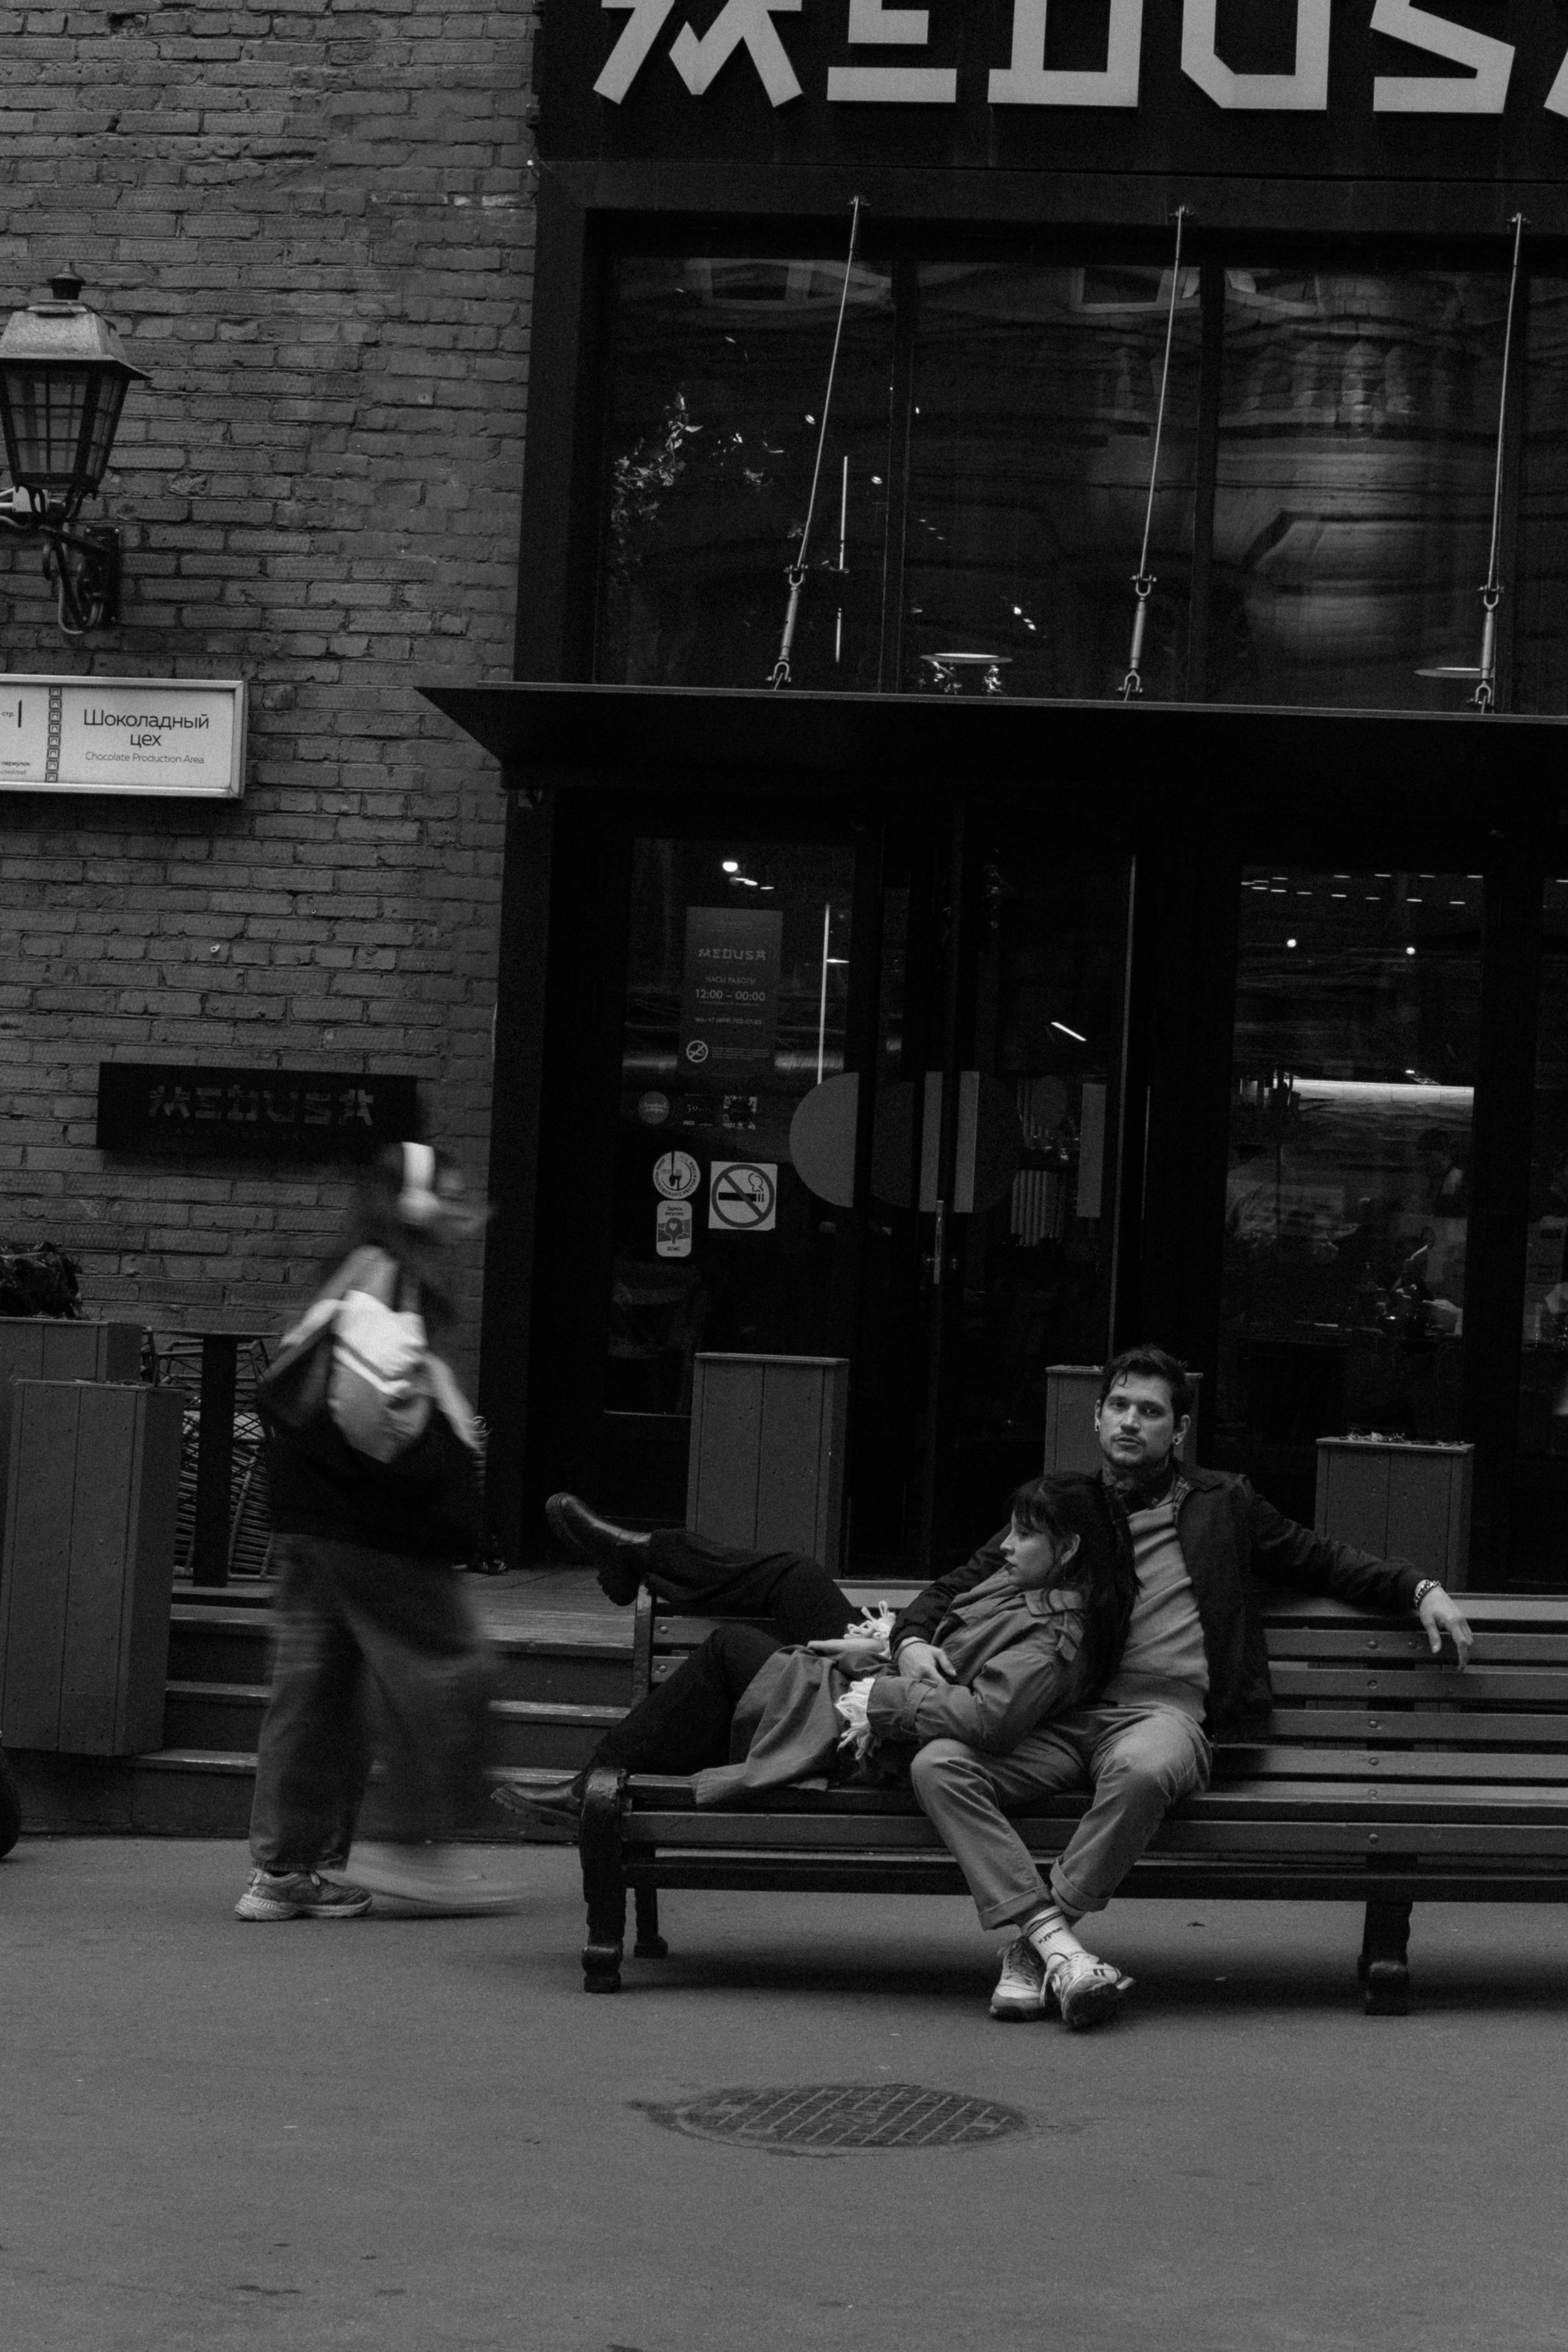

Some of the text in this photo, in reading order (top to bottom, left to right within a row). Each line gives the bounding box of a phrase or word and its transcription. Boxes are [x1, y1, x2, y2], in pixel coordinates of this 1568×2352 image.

[592, 0, 1568, 118] MEDUS
[83, 708, 209, 730] Шоколадный
[130, 734, 162, 748] цех
[85, 752, 205, 764] Chocolate Production Area
[698, 948, 766, 960] MEDUSA
[695, 989, 723, 1000] 12:00
[735, 990, 766, 1001] 00:00
[148, 1085, 374, 1126] MEDUSA
